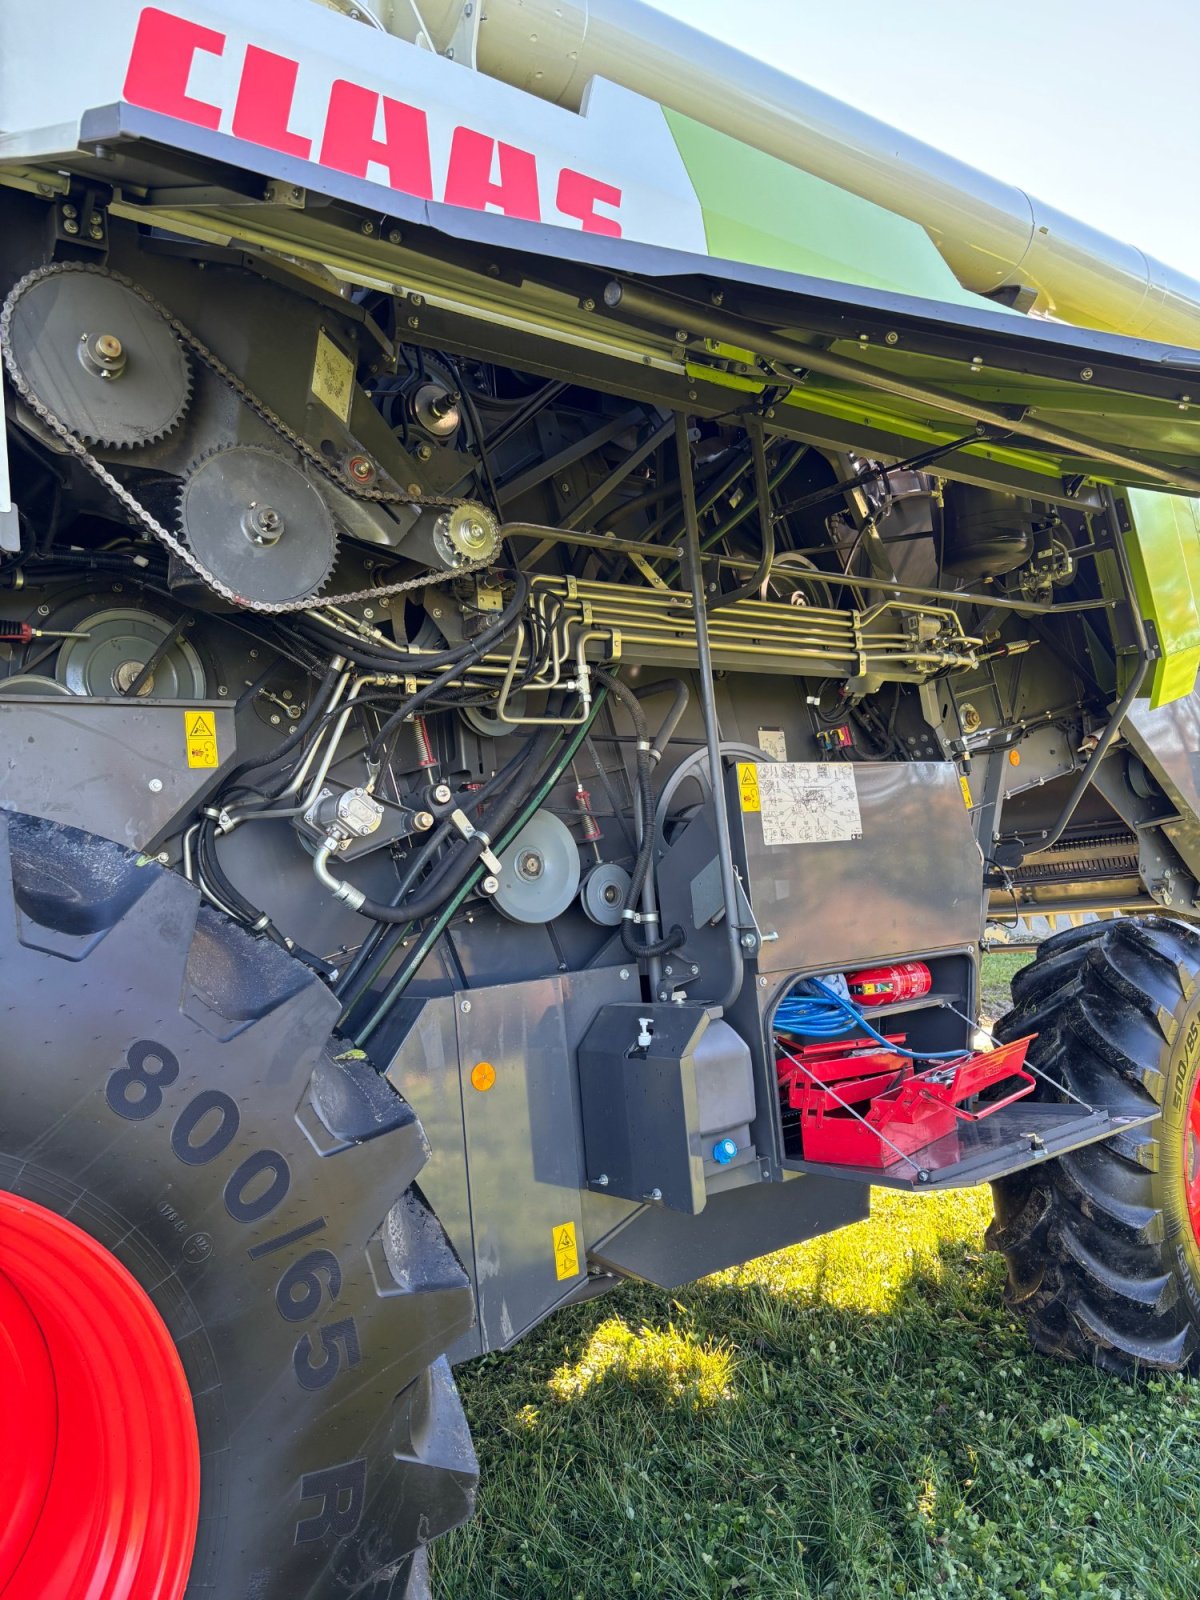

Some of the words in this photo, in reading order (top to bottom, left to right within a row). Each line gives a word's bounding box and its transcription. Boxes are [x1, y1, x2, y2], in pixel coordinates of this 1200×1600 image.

[122, 6, 622, 238] CLAAS
[1173, 1020, 1198, 1112] 500/85
[105, 1039, 362, 1391] 800/65
[294, 1457, 367, 1546] R
